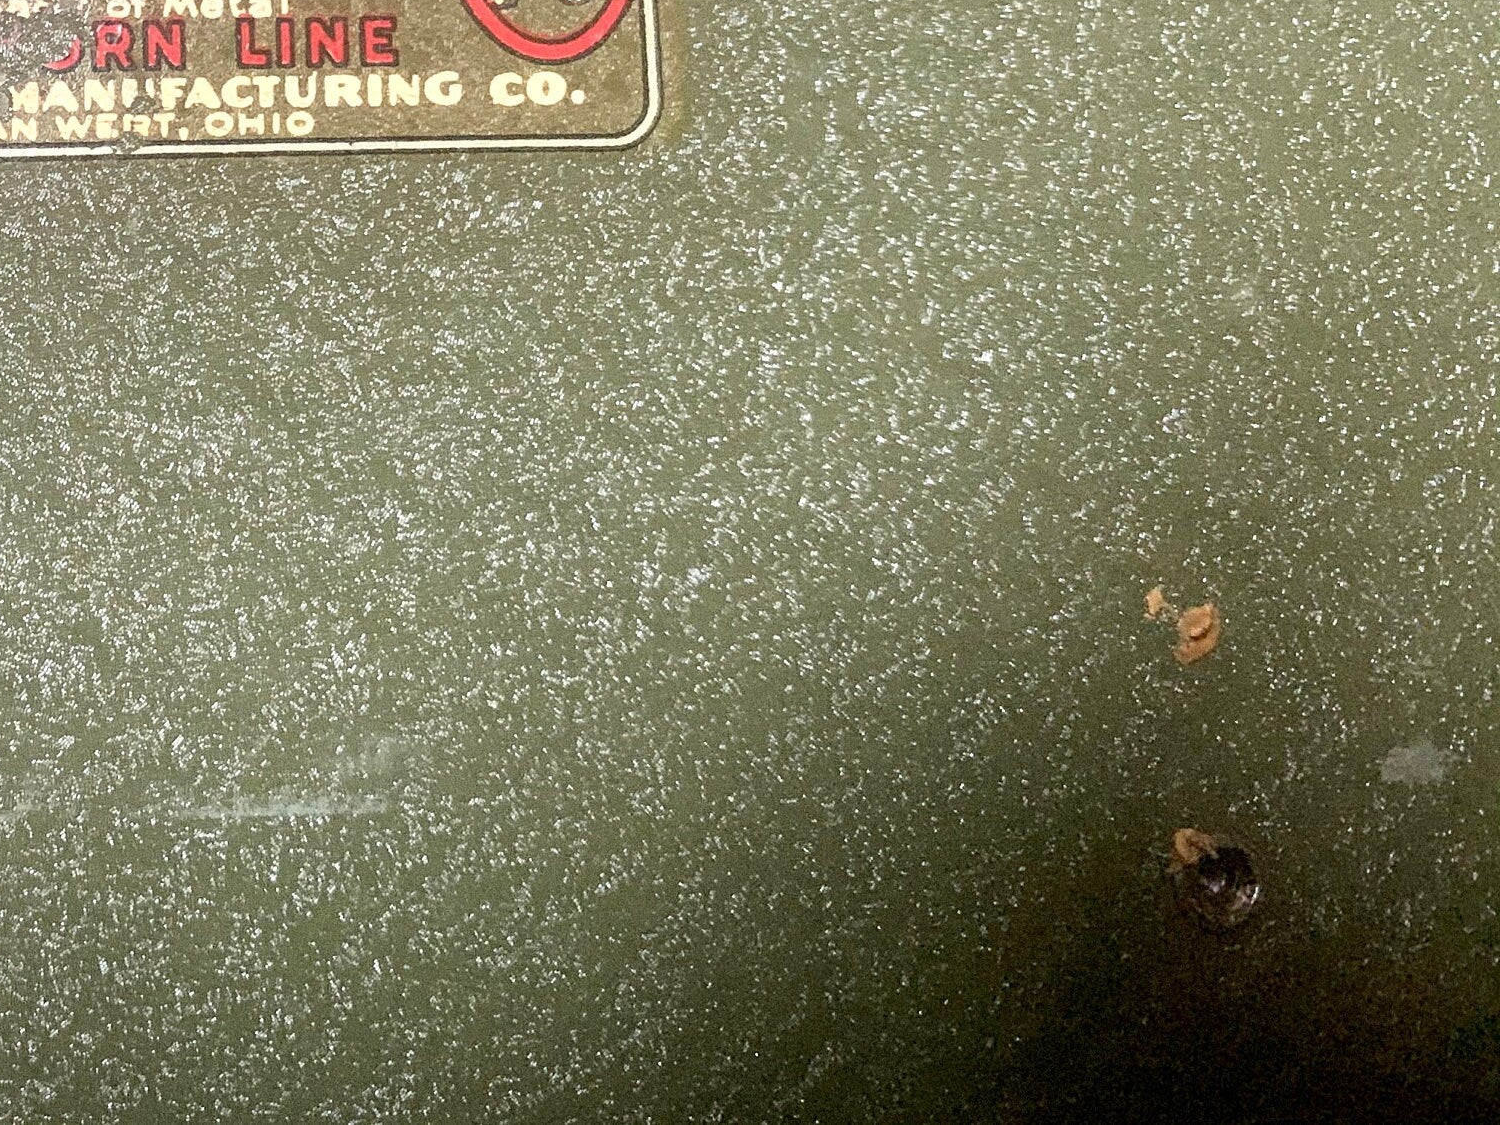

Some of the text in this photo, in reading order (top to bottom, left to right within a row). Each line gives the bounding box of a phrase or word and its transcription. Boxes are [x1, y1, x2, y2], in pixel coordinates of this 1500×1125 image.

[236, 15, 398, 68] LINE
[490, 71, 586, 106] CO.
[55, 112, 190, 140] WERT,
[204, 112, 315, 138] OHIO
